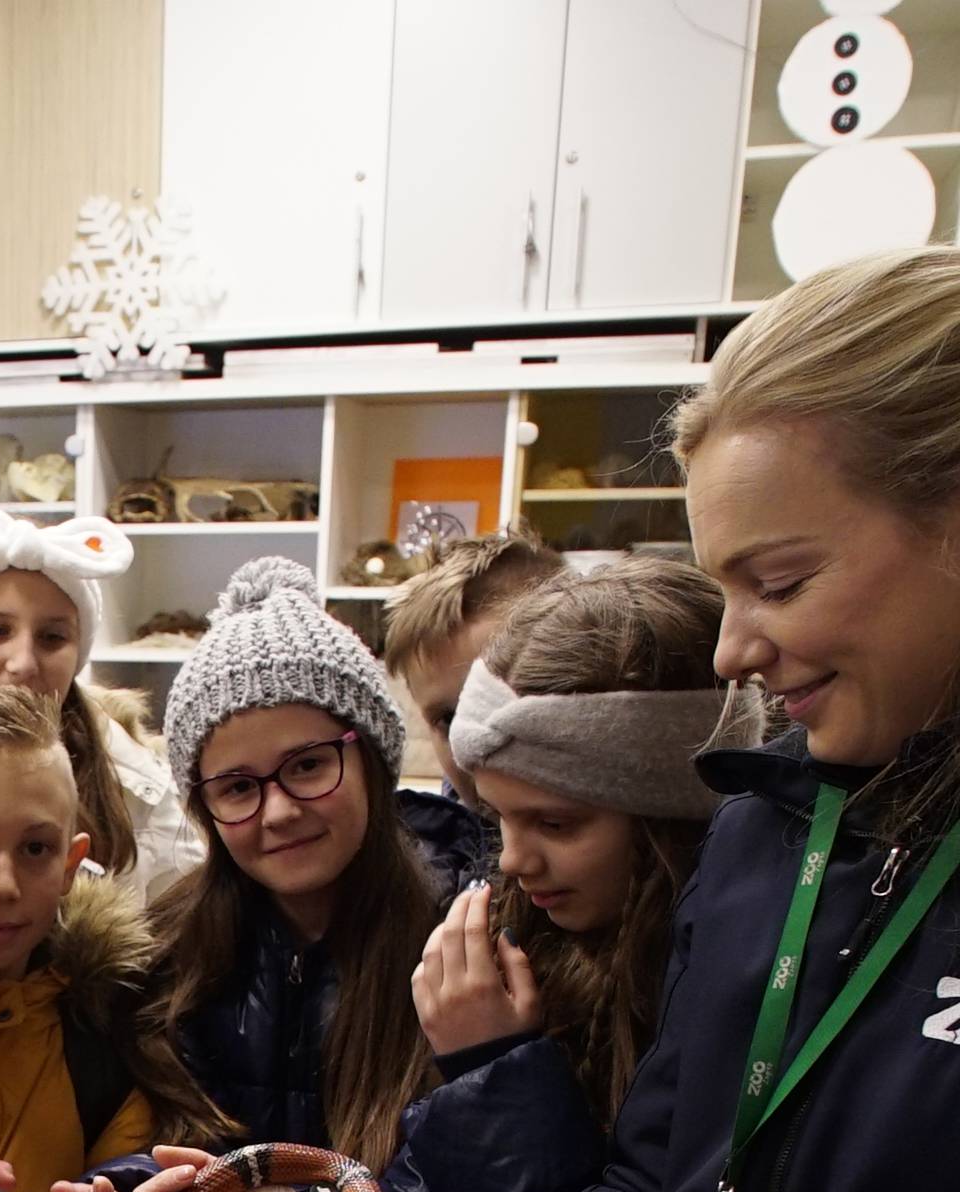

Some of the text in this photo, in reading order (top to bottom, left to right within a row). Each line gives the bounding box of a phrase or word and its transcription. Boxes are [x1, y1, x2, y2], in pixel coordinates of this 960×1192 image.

[801, 852, 820, 885] ZOO
[772, 956, 791, 989] ZOO
[747, 1061, 766, 1096] ZOO
